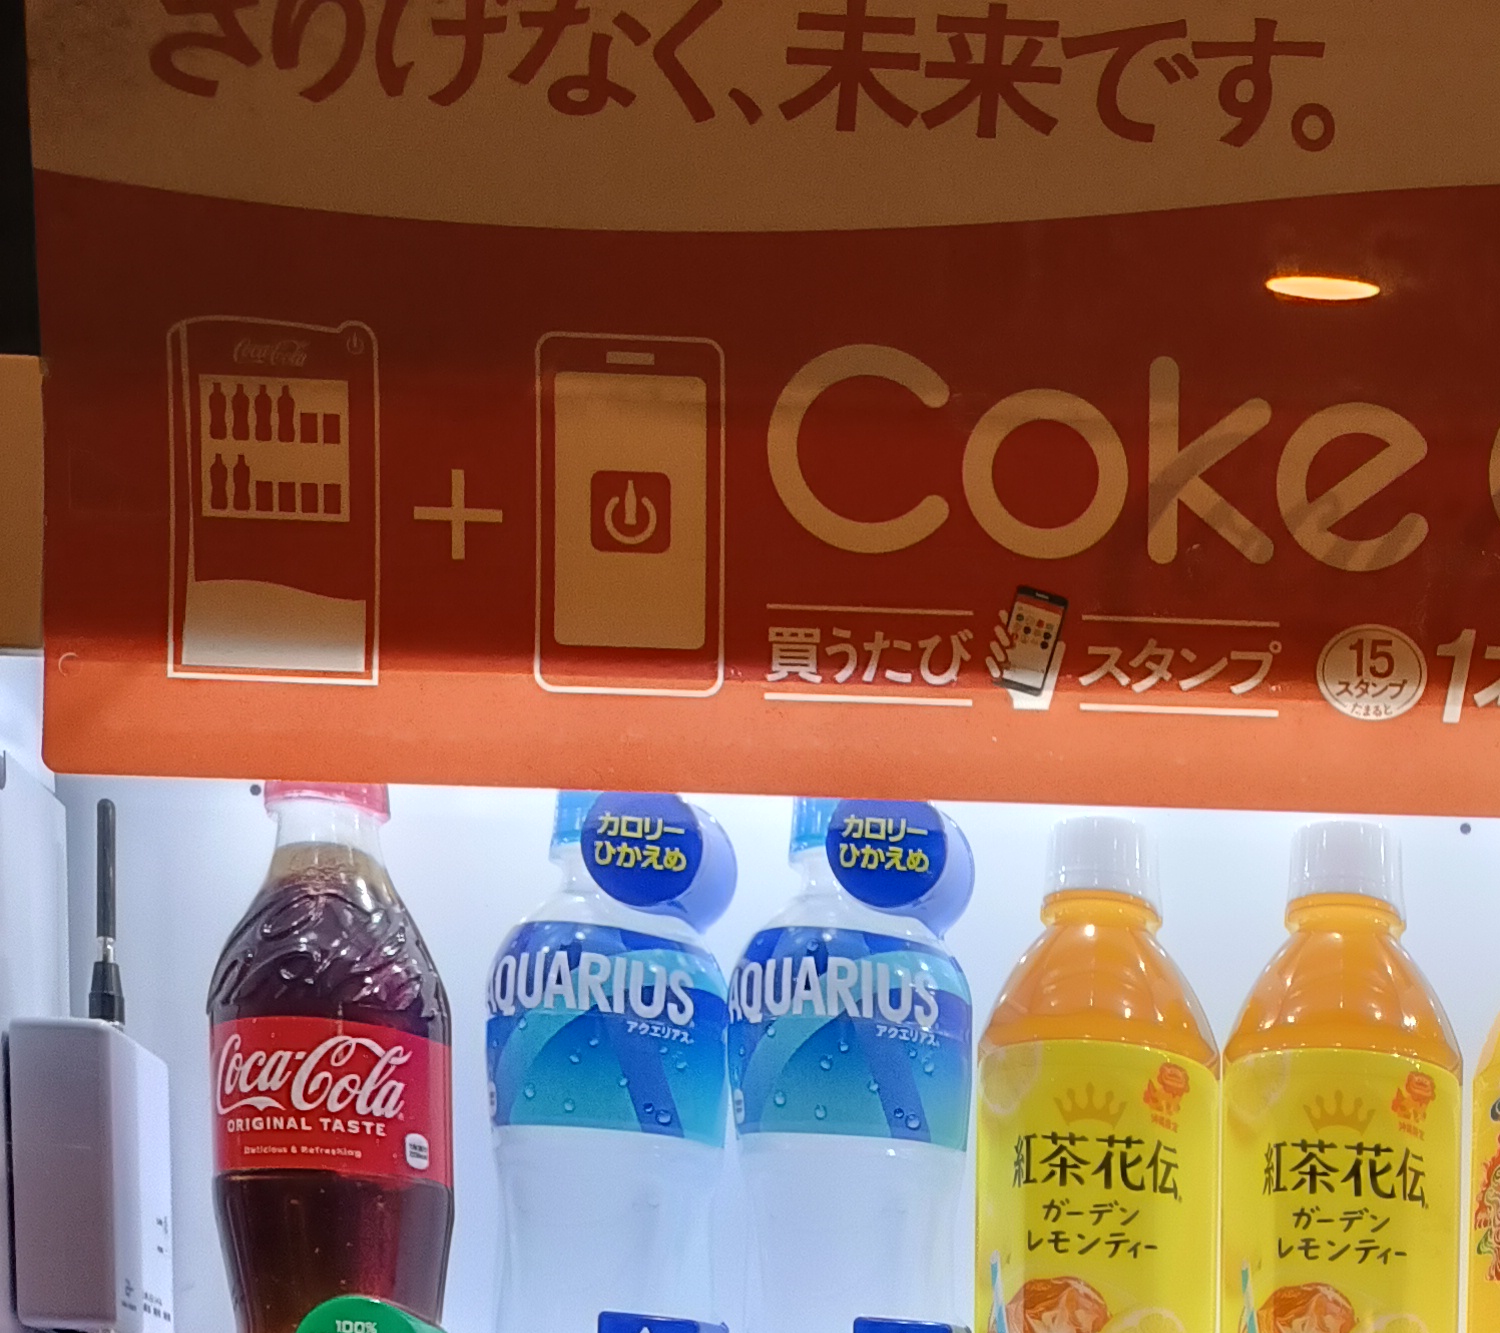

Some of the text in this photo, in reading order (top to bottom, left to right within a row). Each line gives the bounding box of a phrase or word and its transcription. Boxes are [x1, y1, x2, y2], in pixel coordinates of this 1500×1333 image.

[767, 344, 1428, 572] Coke
[766, 625, 972, 685] 買うたび
[1079, 638, 1282, 695] スタンプ
[1348, 639, 1395, 679] 15
[1334, 676, 1408, 700] スタンプ
[594, 840, 687, 873] ひかえめ
[216, 1033, 411, 1119] Coca-Cola
[227, 1117, 387, 1137] ORIGINAL TASTE
[1012, 1131, 1179, 1196] 紅茶花伝
[1293, 1207, 1391, 1232] ガーデン
[1028, 1230, 1158, 1259] レモンティー
